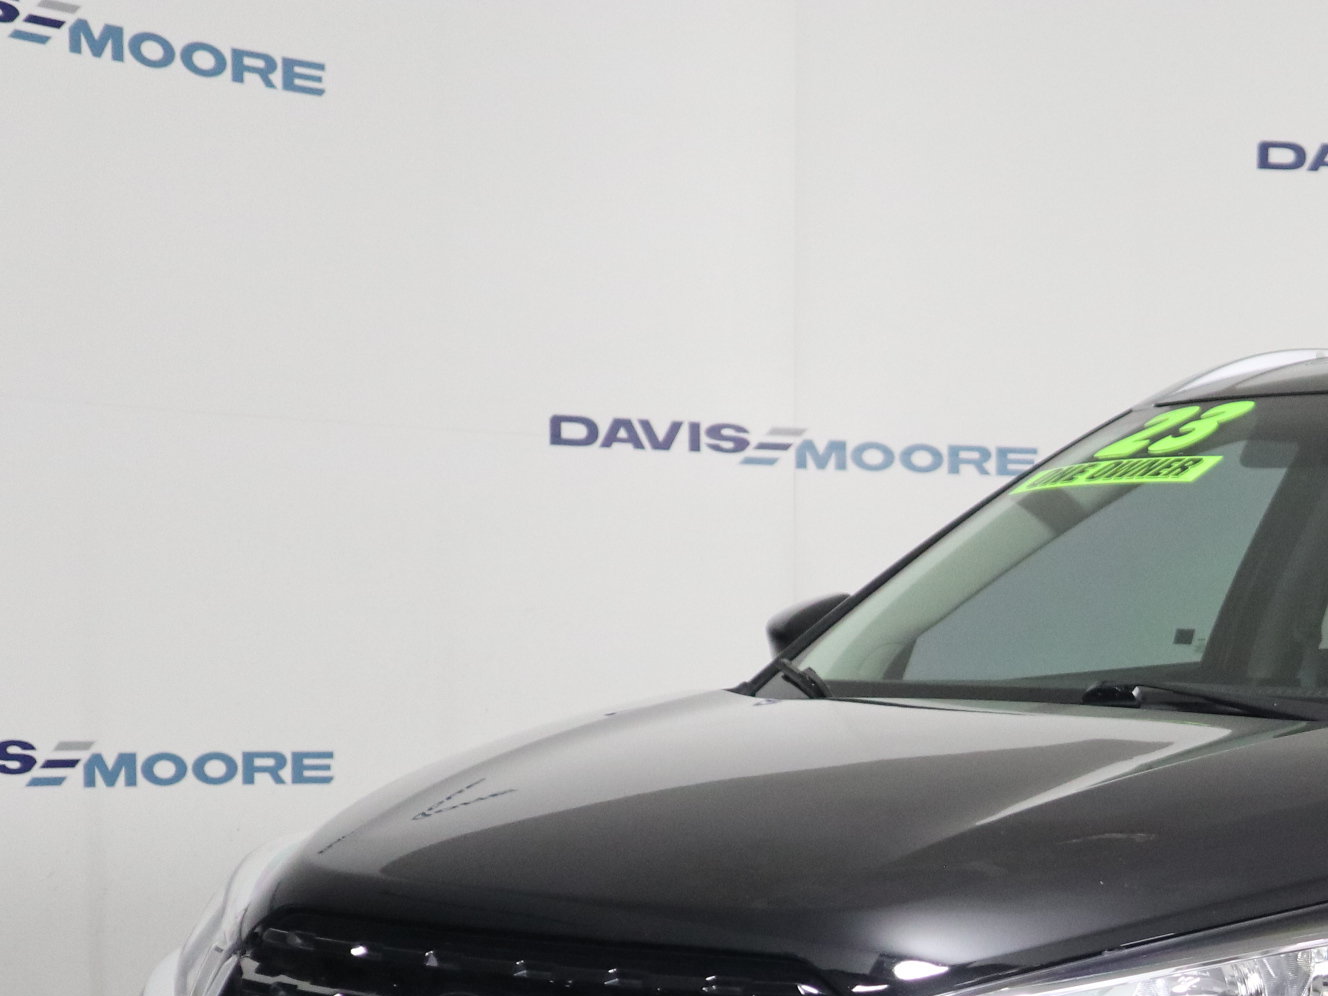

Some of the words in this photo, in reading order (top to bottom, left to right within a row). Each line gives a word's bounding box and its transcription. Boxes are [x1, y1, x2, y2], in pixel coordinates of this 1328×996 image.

[68, 18, 326, 96] MOORE
[549, 414, 750, 454] DAVIS
[795, 439, 1039, 477] MOORE
[1093, 400, 1256, 459] 23
[1087, 457, 1204, 480] OWNER
[83, 751, 334, 788] MOORE
